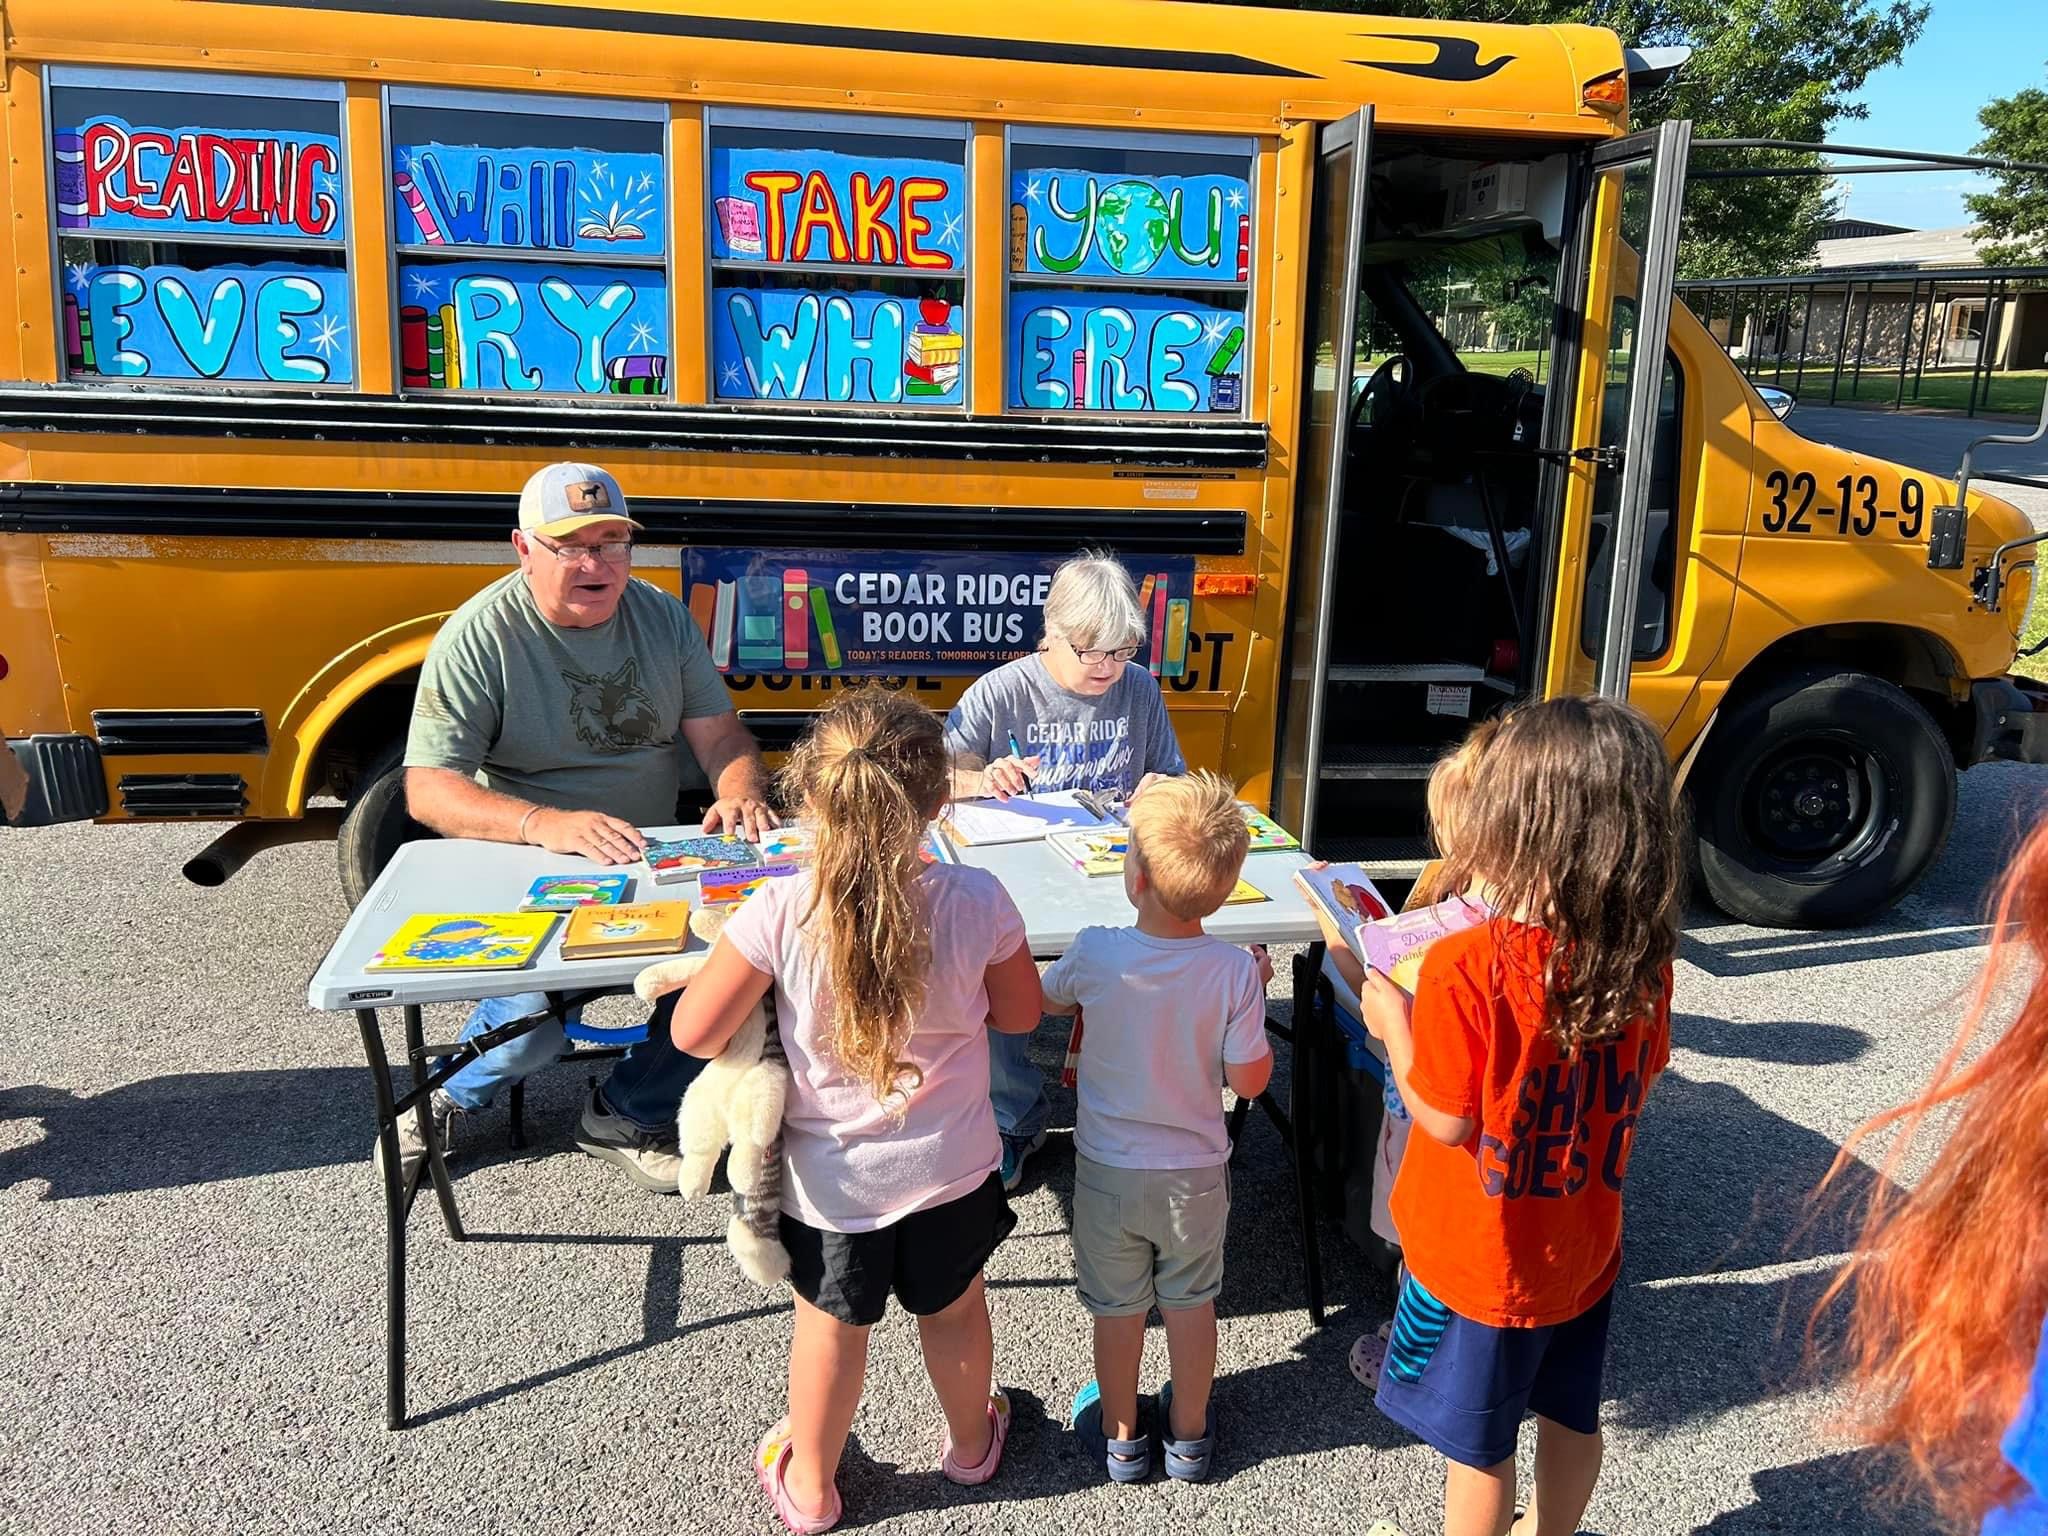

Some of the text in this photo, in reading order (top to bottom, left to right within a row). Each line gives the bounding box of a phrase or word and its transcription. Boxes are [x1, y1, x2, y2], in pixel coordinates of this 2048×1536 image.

[84, 121, 338, 235] READING
[745, 169, 953, 270] TAKE
[88, 270, 1203, 412] EVE RY WH ERE
[1762, 469, 1924, 538] 32-13-9
[835, 572, 1051, 607] CEDAR RIDGE
[862, 611, 1024, 645] BOOK BUS
[847, 650, 885, 660] TODAY'S
[888, 650, 934, 661] READERS,
[937, 650, 995, 660] TOMORROW'S
[1026, 715, 1129, 744] CEDAR RIDG
[610, 908, 667, 921] Duck
[354, 990, 389, 1000] LIFETIME
[1511, 1039, 1651, 1139] SHOW
[1477, 1120, 1590, 1200] GOES
